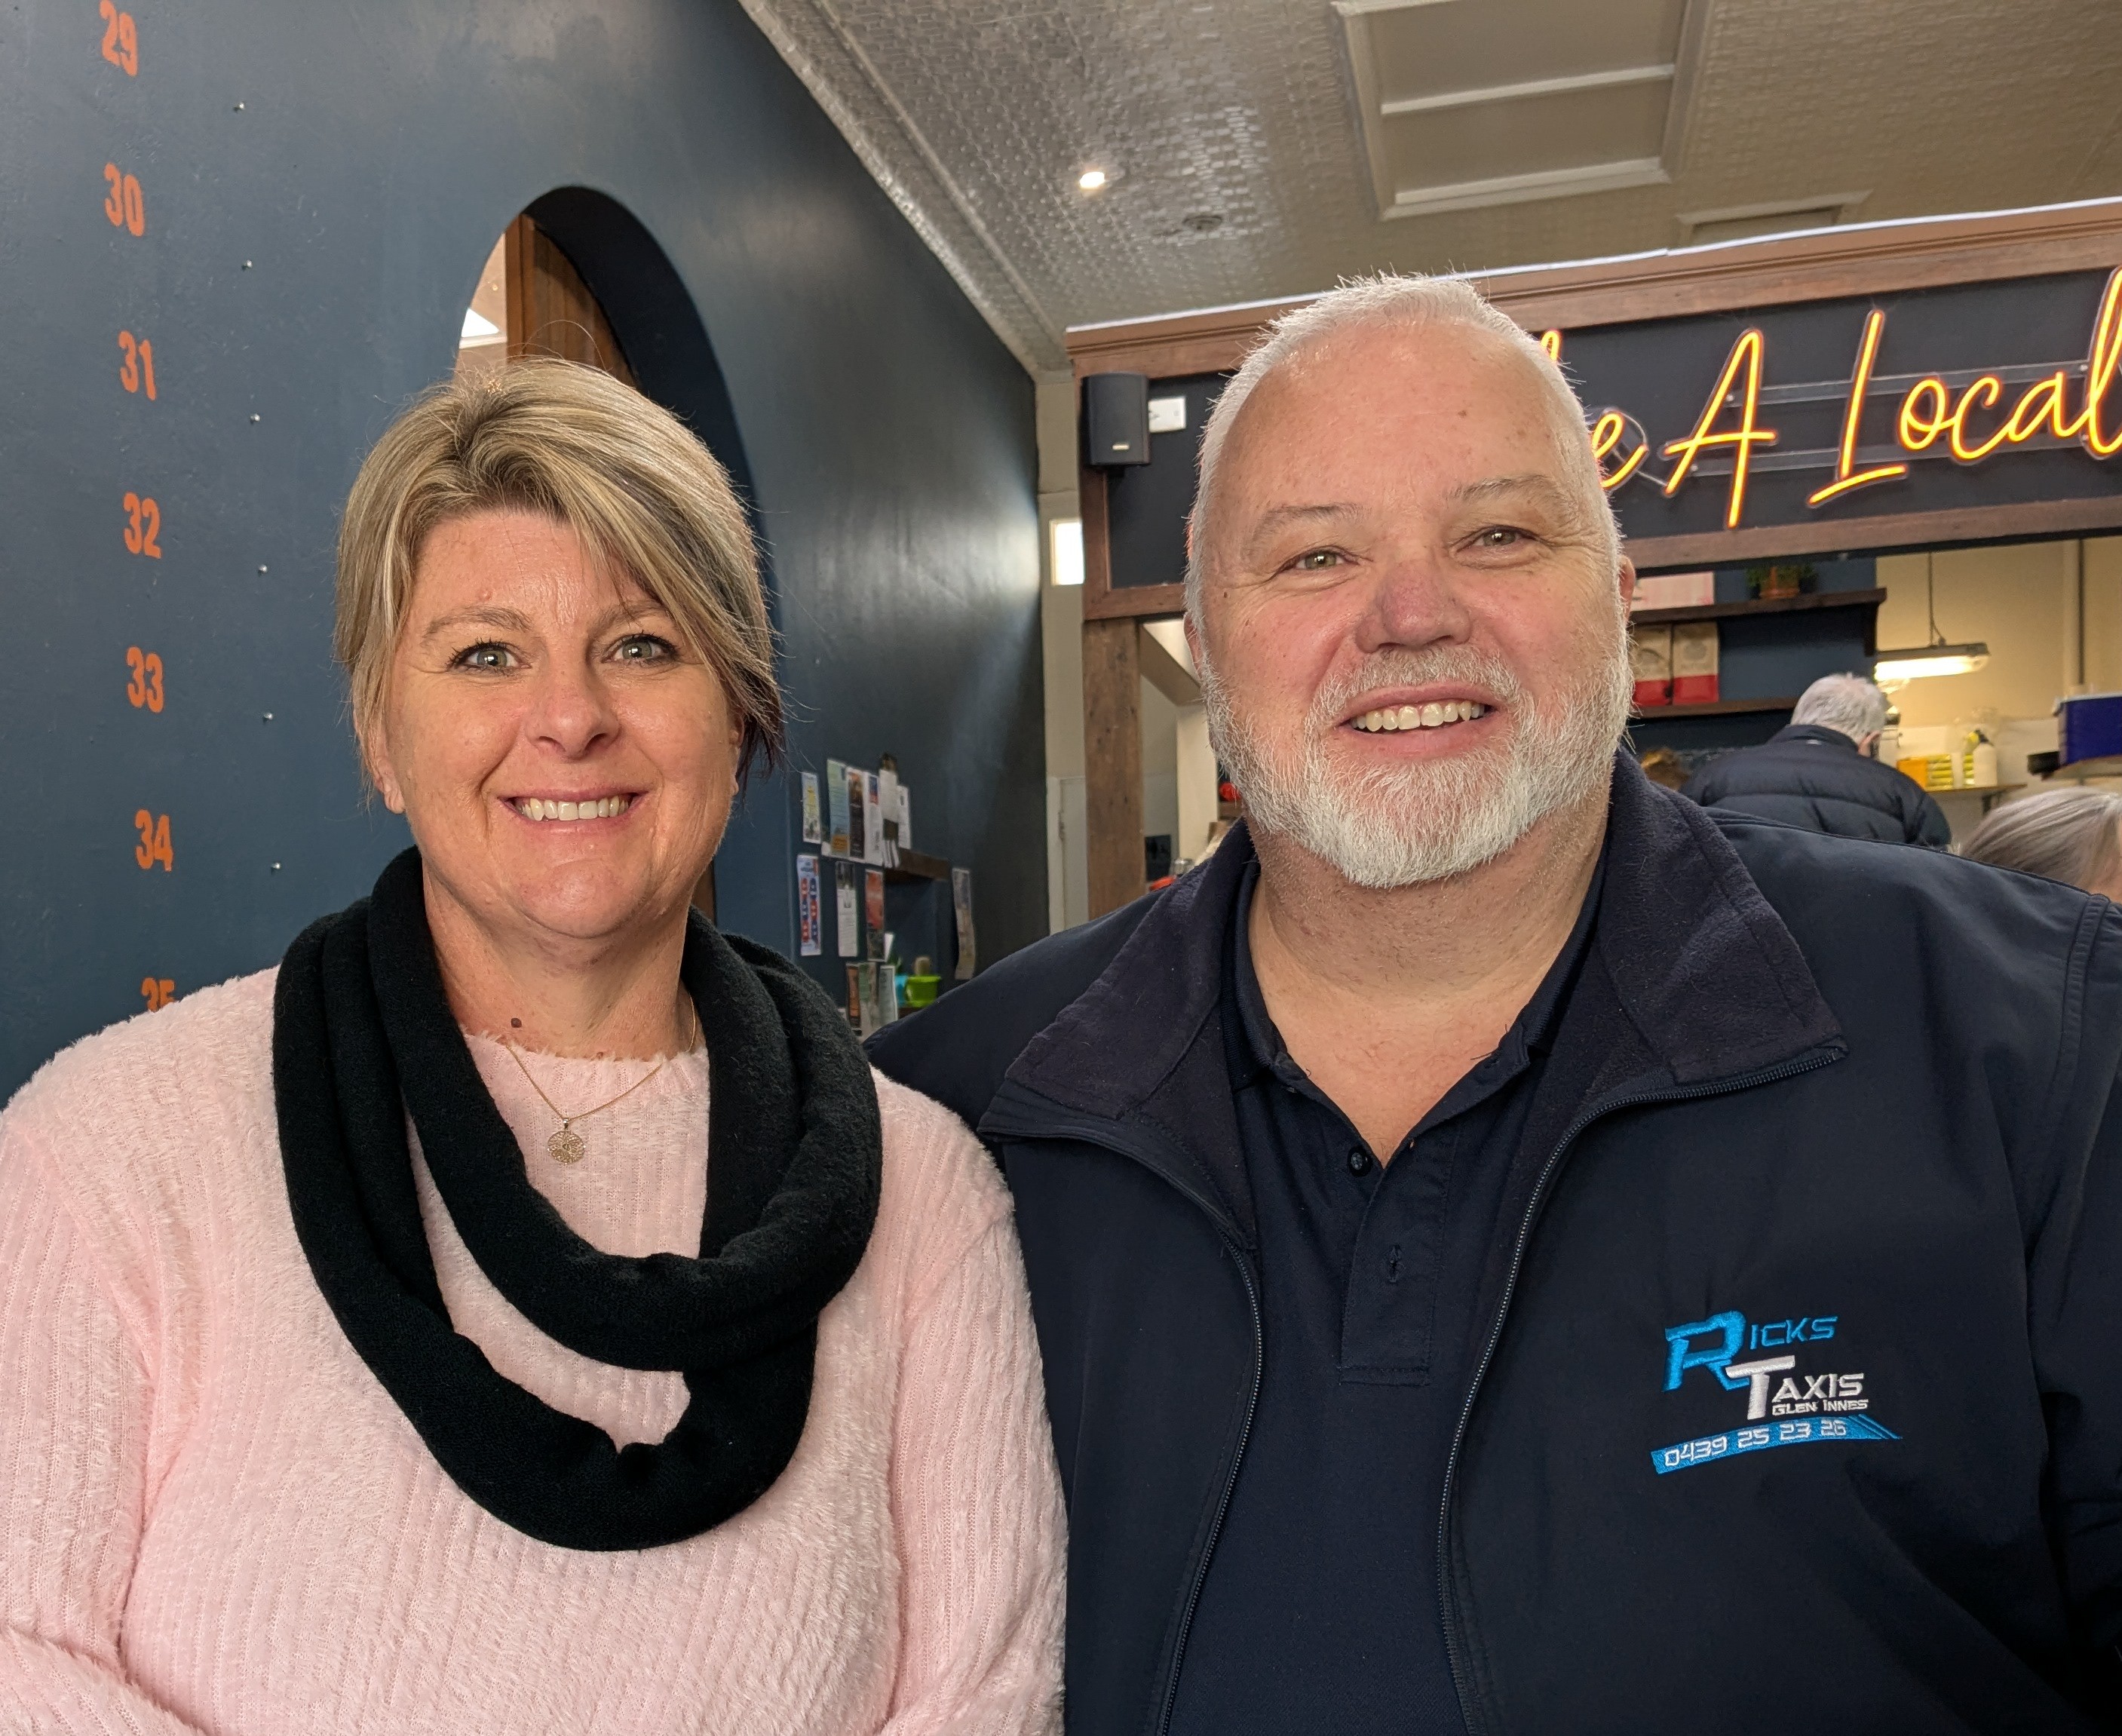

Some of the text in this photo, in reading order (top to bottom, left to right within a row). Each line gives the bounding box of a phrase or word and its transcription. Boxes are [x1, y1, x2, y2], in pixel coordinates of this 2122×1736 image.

[100, 0, 137, 76] 29
[105, 163, 145, 237] 30
[118, 330, 157, 400] 31
[1663, 330, 1777, 529] A
[1809, 265, 2122, 506] Local
[123, 492, 161, 559] 32
[126, 646, 164, 713] 33
[135, 809, 173, 872] 34
[1661, 1311, 1838, 1393] RICKS
[1725, 1355, 1865, 1421] TAXIS
[1771, 1399, 1869, 1416] GLEN INNES
[1664, 1419, 1847, 1468] 0439 25 23 26
